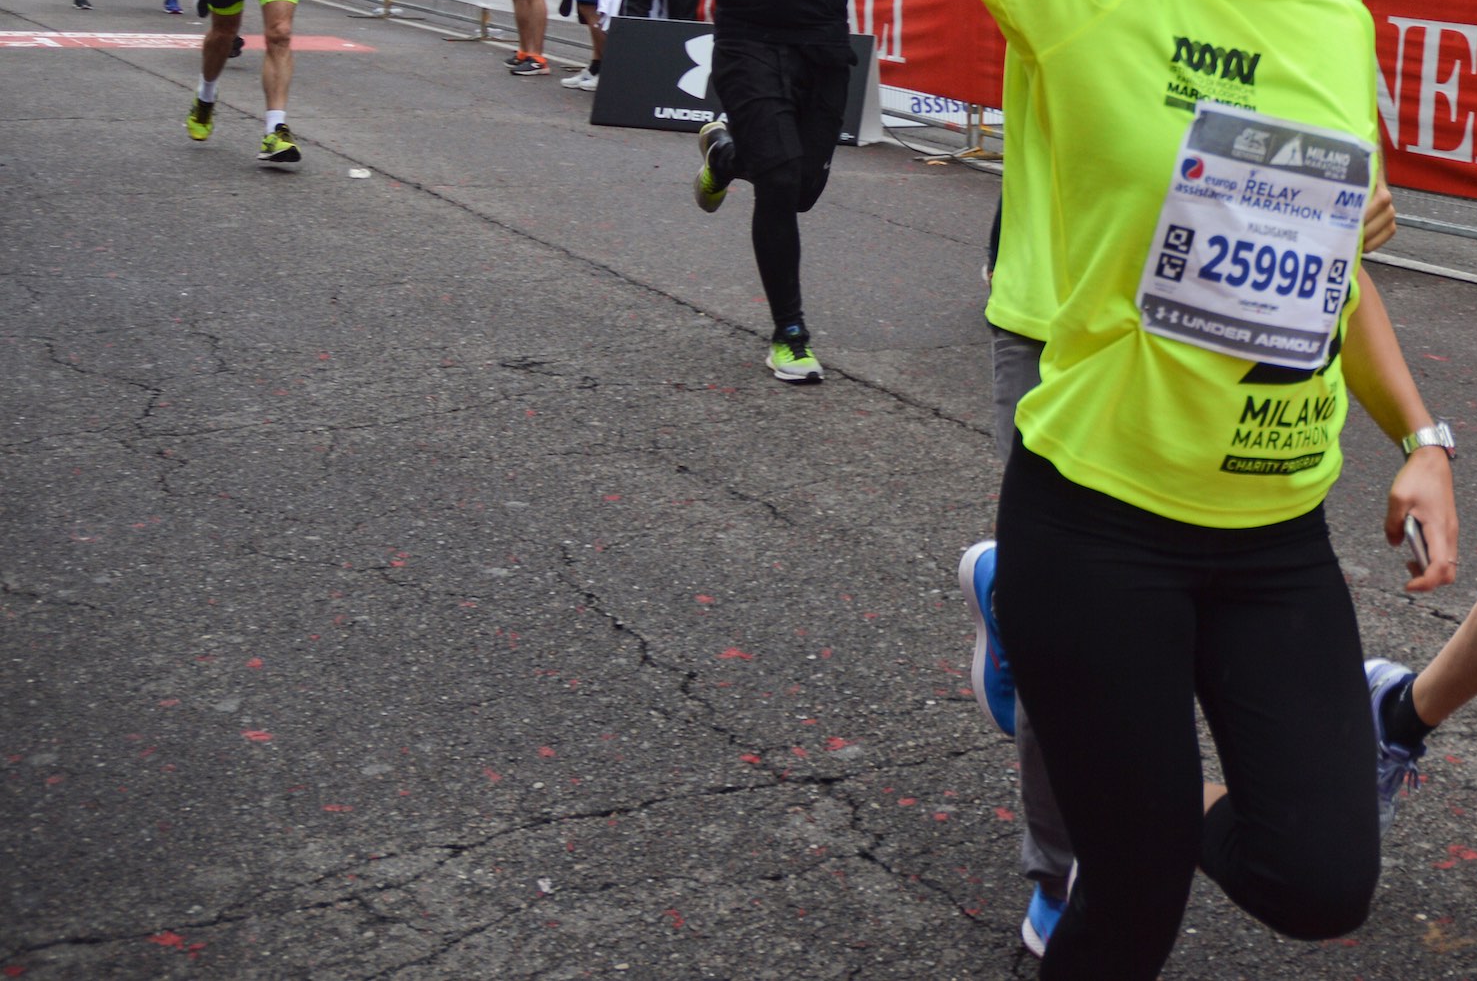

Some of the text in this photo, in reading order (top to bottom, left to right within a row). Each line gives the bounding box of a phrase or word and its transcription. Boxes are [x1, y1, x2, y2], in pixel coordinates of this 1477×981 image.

[654, 107, 714, 122] UNDER
[1306, 146, 1350, 166] MILANO
[1204, 175, 1238, 191] europ
[1244, 179, 1302, 201] RELAY
[1239, 193, 1323, 222] MARATHON
[1198, 235, 1323, 300] 2599B
[1181, 314, 1252, 343] UNDER
[1239, 395, 1336, 428] MILANO
[1231, 427, 1329, 451] MARATHON
[1226, 459, 1279, 473] CHARITY
